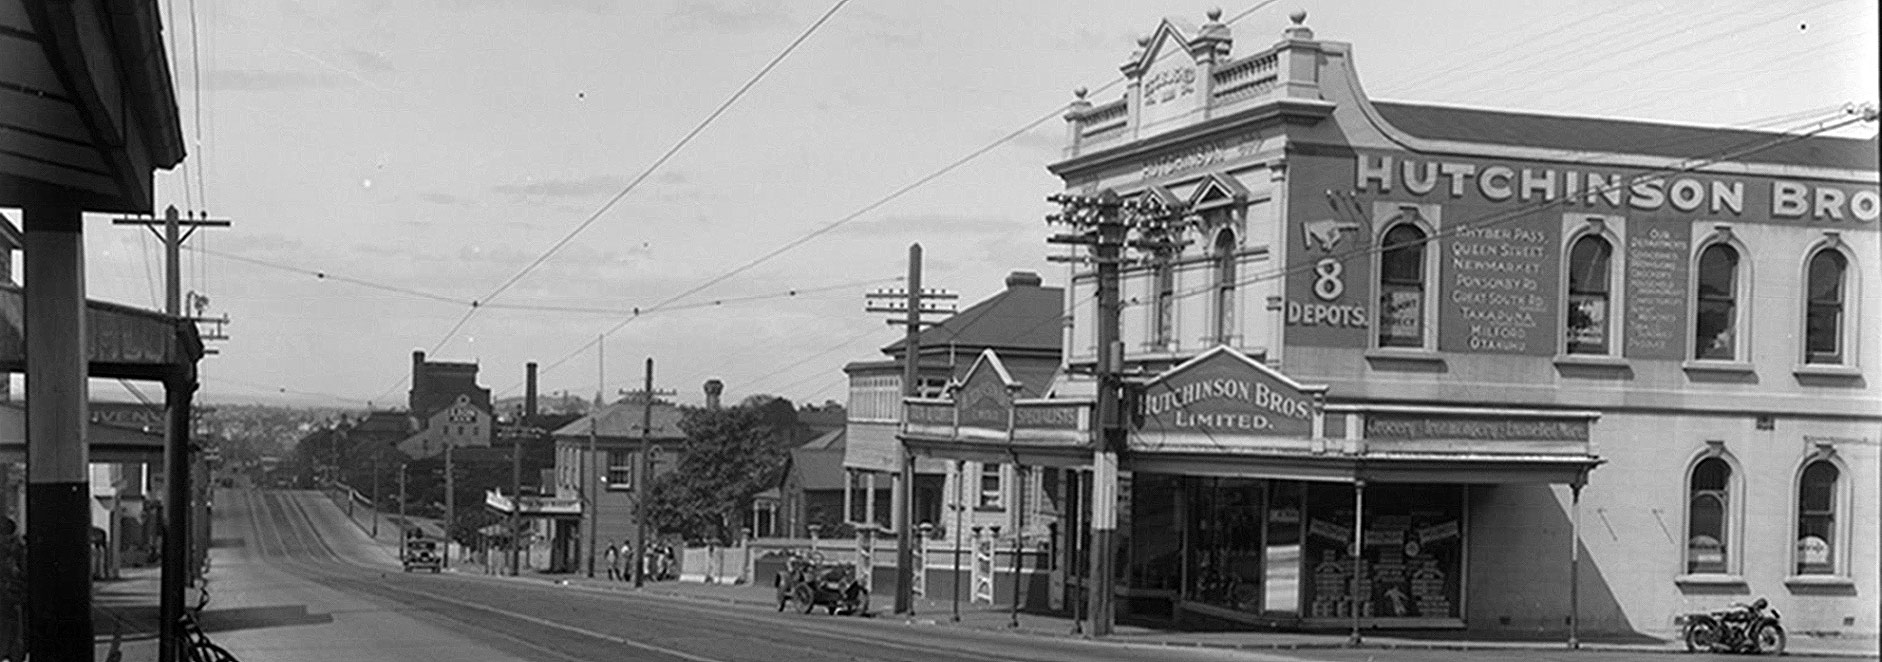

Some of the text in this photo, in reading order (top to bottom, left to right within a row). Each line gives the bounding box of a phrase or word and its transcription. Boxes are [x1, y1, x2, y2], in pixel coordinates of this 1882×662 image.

[1355, 153, 1879, 222] HUTCHINSON BRO
[1452, 241, 1497, 256] QUEEN
[1312, 257, 1345, 301] 8
[1286, 300, 1369, 328] DEPOTS.
[1470, 324, 1526, 339] MILFORD
[1138, 378, 1250, 416] HUTCHINSON
